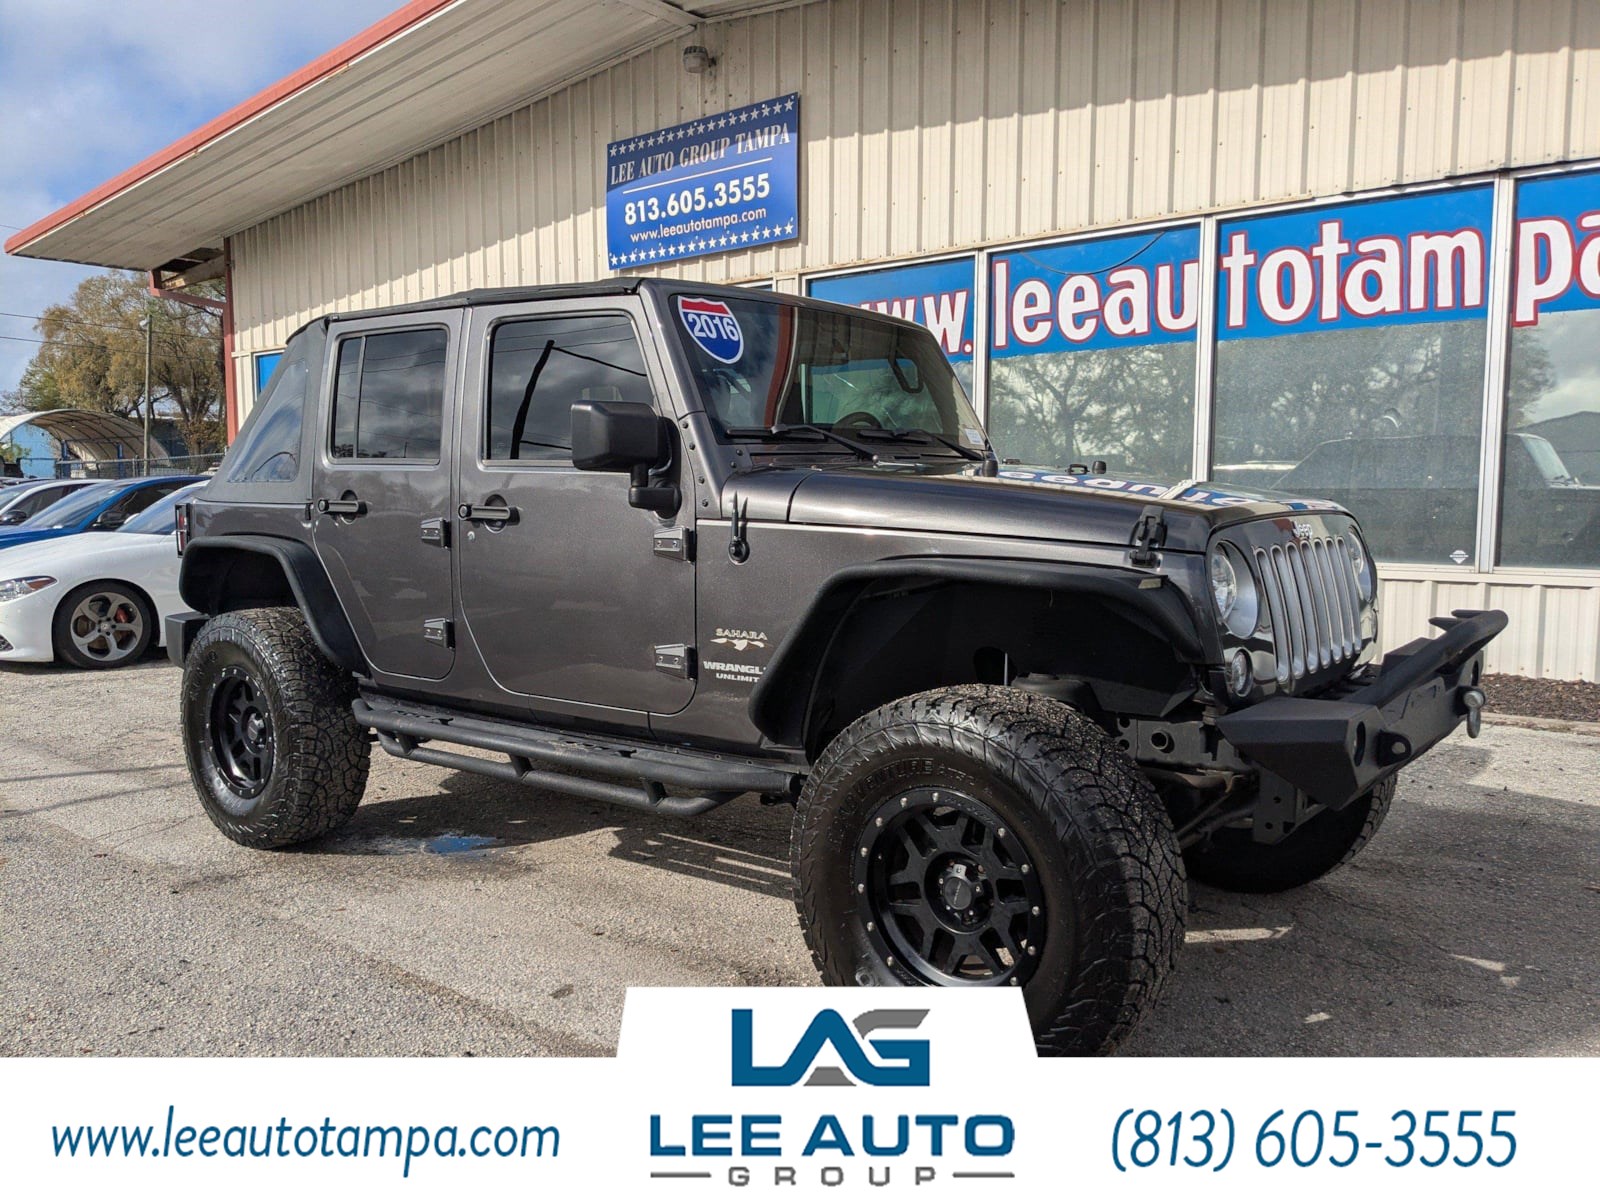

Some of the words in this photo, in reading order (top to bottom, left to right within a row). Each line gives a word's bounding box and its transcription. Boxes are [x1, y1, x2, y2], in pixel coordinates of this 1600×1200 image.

[610, 160, 635, 185] LEE
[638, 151, 674, 178] AUTO
[679, 137, 731, 168] GROUP
[735, 122, 791, 155] TAMPA
[624, 172, 770, 226] 813.605.3555
[630, 207, 767, 243] www.leeautotampa.com
[687, 313, 739, 341] 2016
[715, 628, 768, 641] SAHARA
[703, 661, 767, 675] WRANGL
[715, 673, 760, 683] UNLIMIT
